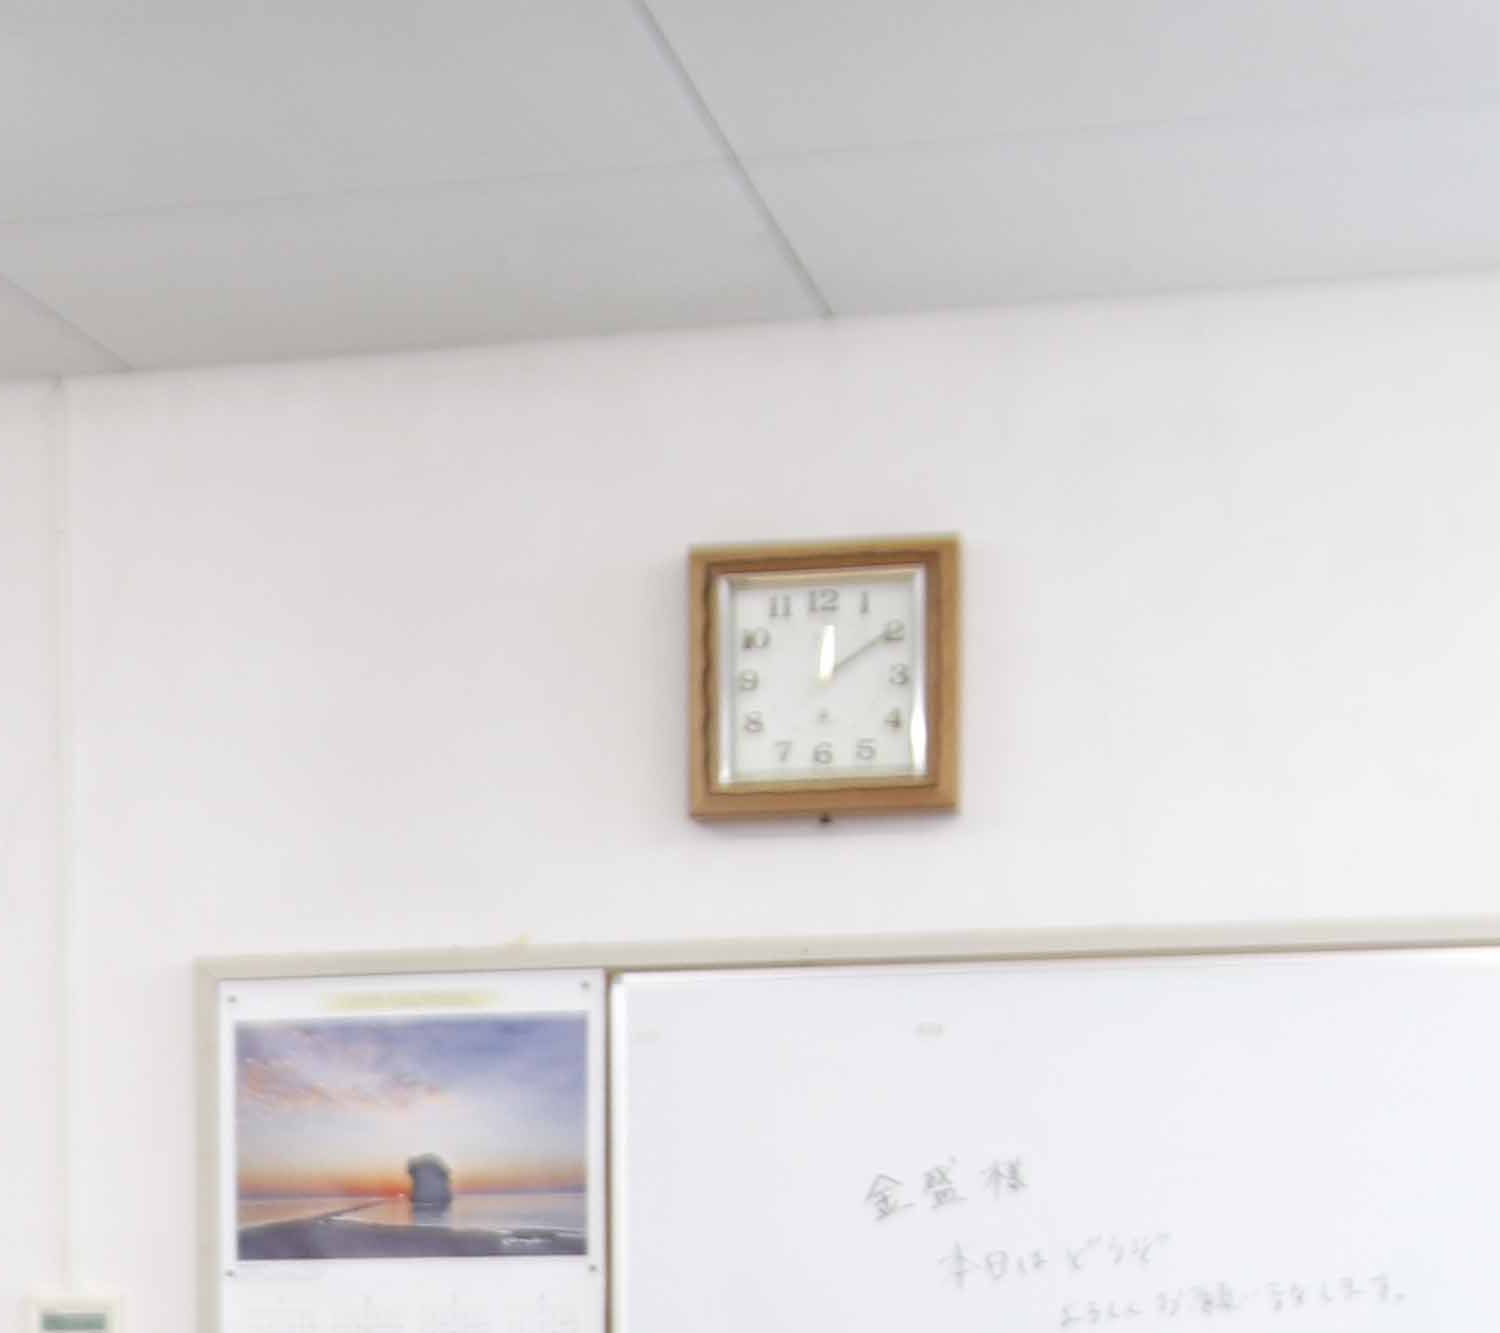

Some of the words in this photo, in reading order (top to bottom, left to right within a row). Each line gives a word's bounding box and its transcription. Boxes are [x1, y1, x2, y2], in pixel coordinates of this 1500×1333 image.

[768, 596, 792, 618] 11
[807, 588, 840, 614] 12
[859, 591, 870, 614] 1
[741, 627, 771, 650] 10
[884, 618, 905, 642] 2
[738, 669, 761, 692] 9
[888, 663, 910, 687] 3
[743, 711, 764, 734] 8
[884, 707, 903, 729] 4
[775, 740, 793, 763] 7
[811, 741, 833, 765] 6
[855, 737, 877, 761] 5
